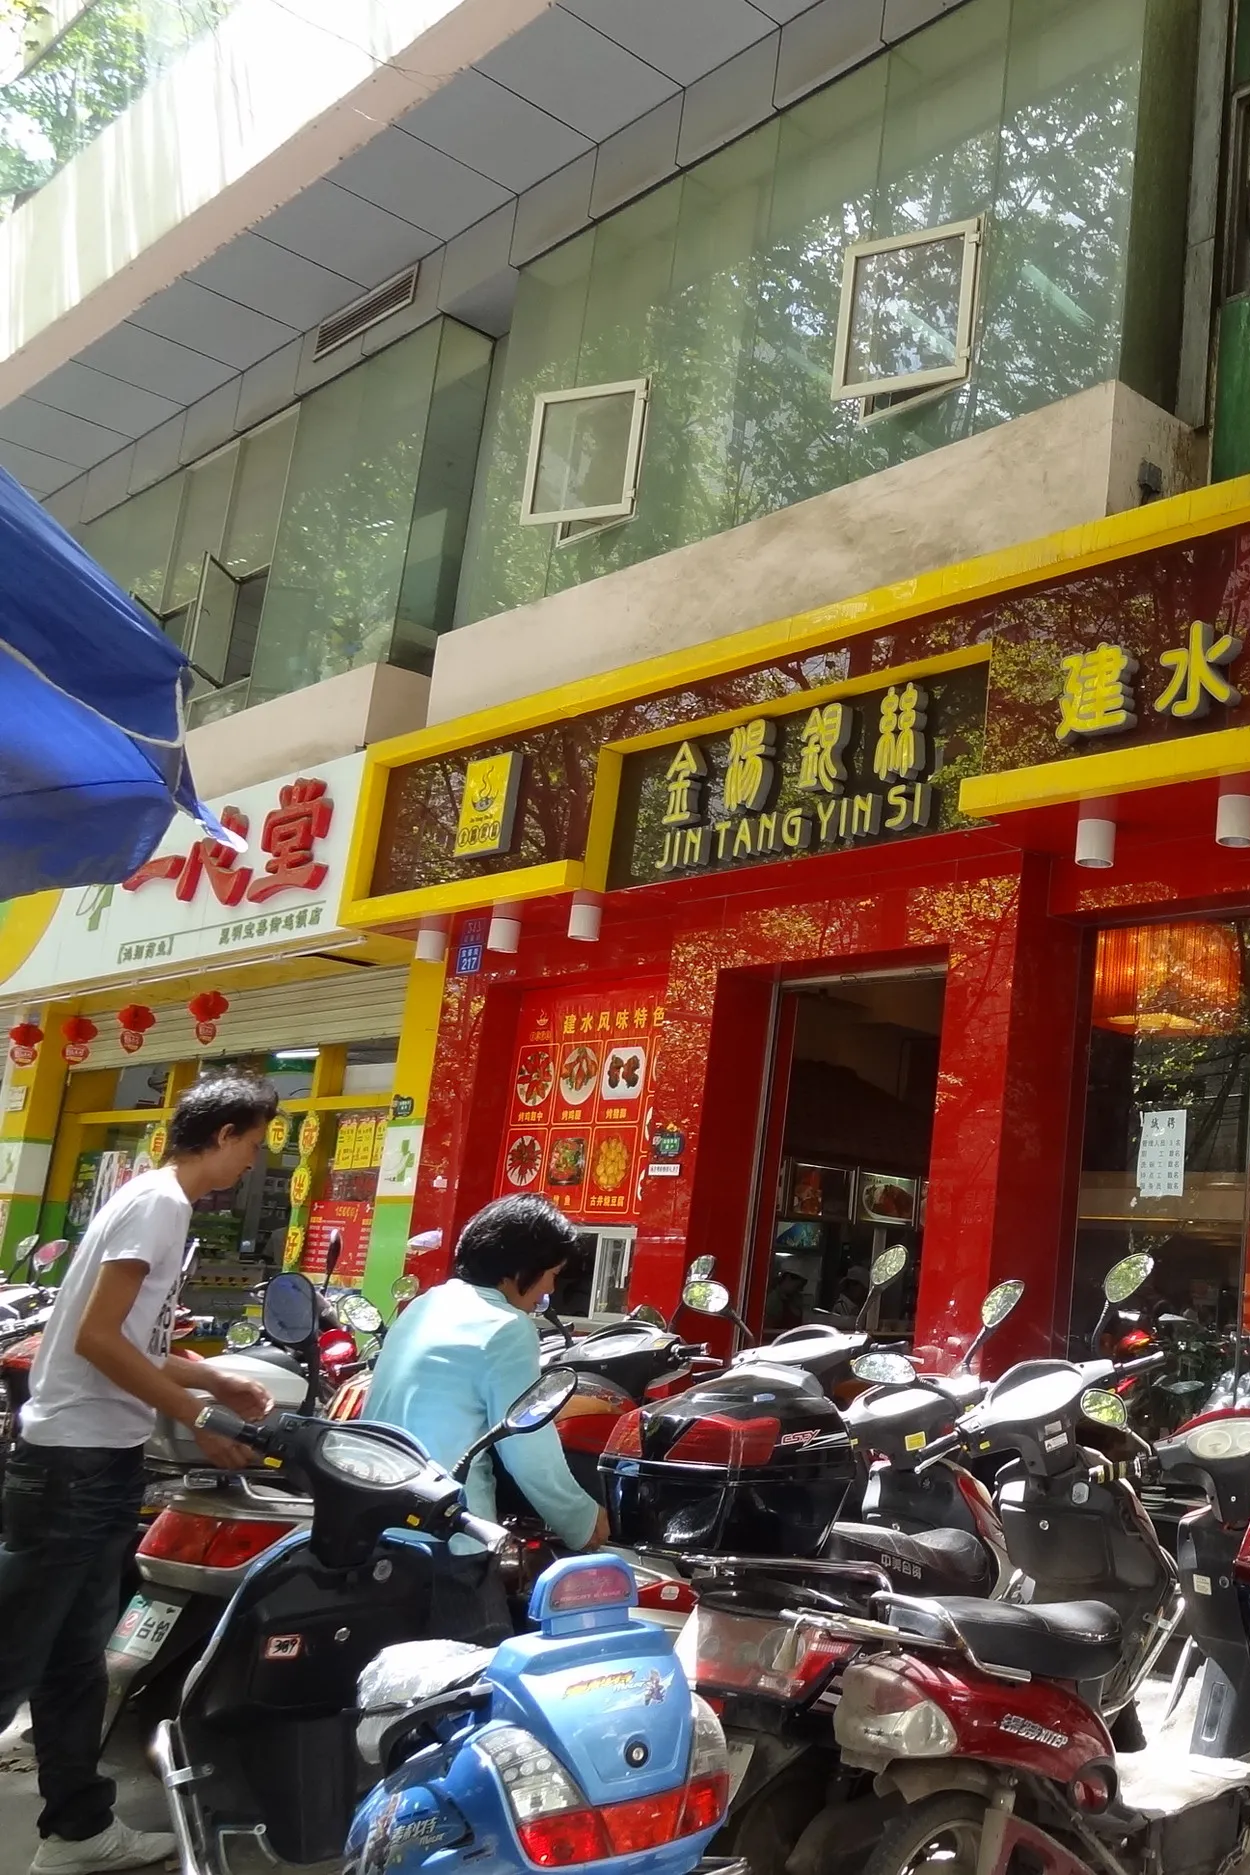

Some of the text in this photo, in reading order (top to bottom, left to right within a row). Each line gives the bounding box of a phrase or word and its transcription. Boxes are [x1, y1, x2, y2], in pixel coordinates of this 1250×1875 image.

[655, 783, 929, 870] JIN TANG YIN SI
[460, 957, 477, 971] 217
[562, 1006, 667, 1035] 建水风味特色
